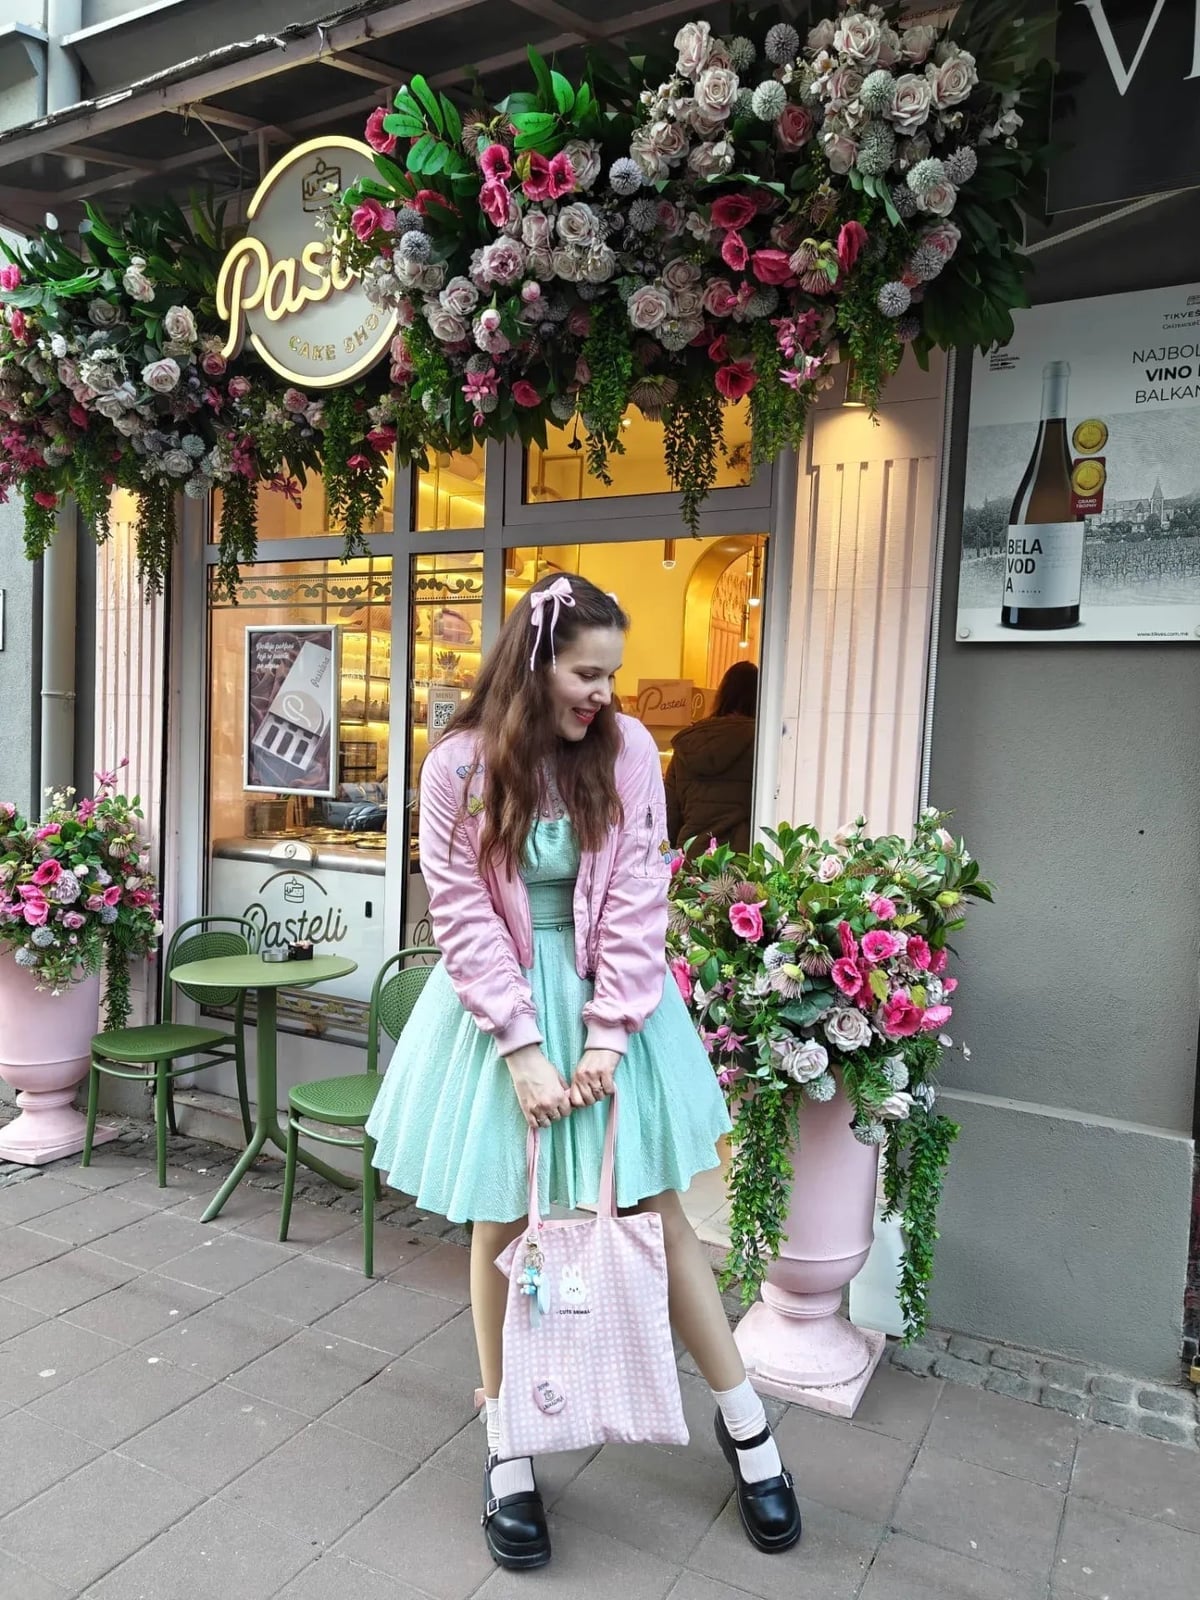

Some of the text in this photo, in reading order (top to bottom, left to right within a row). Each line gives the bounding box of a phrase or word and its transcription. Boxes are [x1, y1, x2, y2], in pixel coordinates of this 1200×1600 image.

[289, 302, 388, 361] CAKE SHO
[1145, 365, 1192, 382] VINO
[1008, 538, 1043, 555] BELA
[1007, 558, 1036, 574] VOD
[1005, 577, 1014, 592] A
[240, 903, 348, 949] Pasteli
